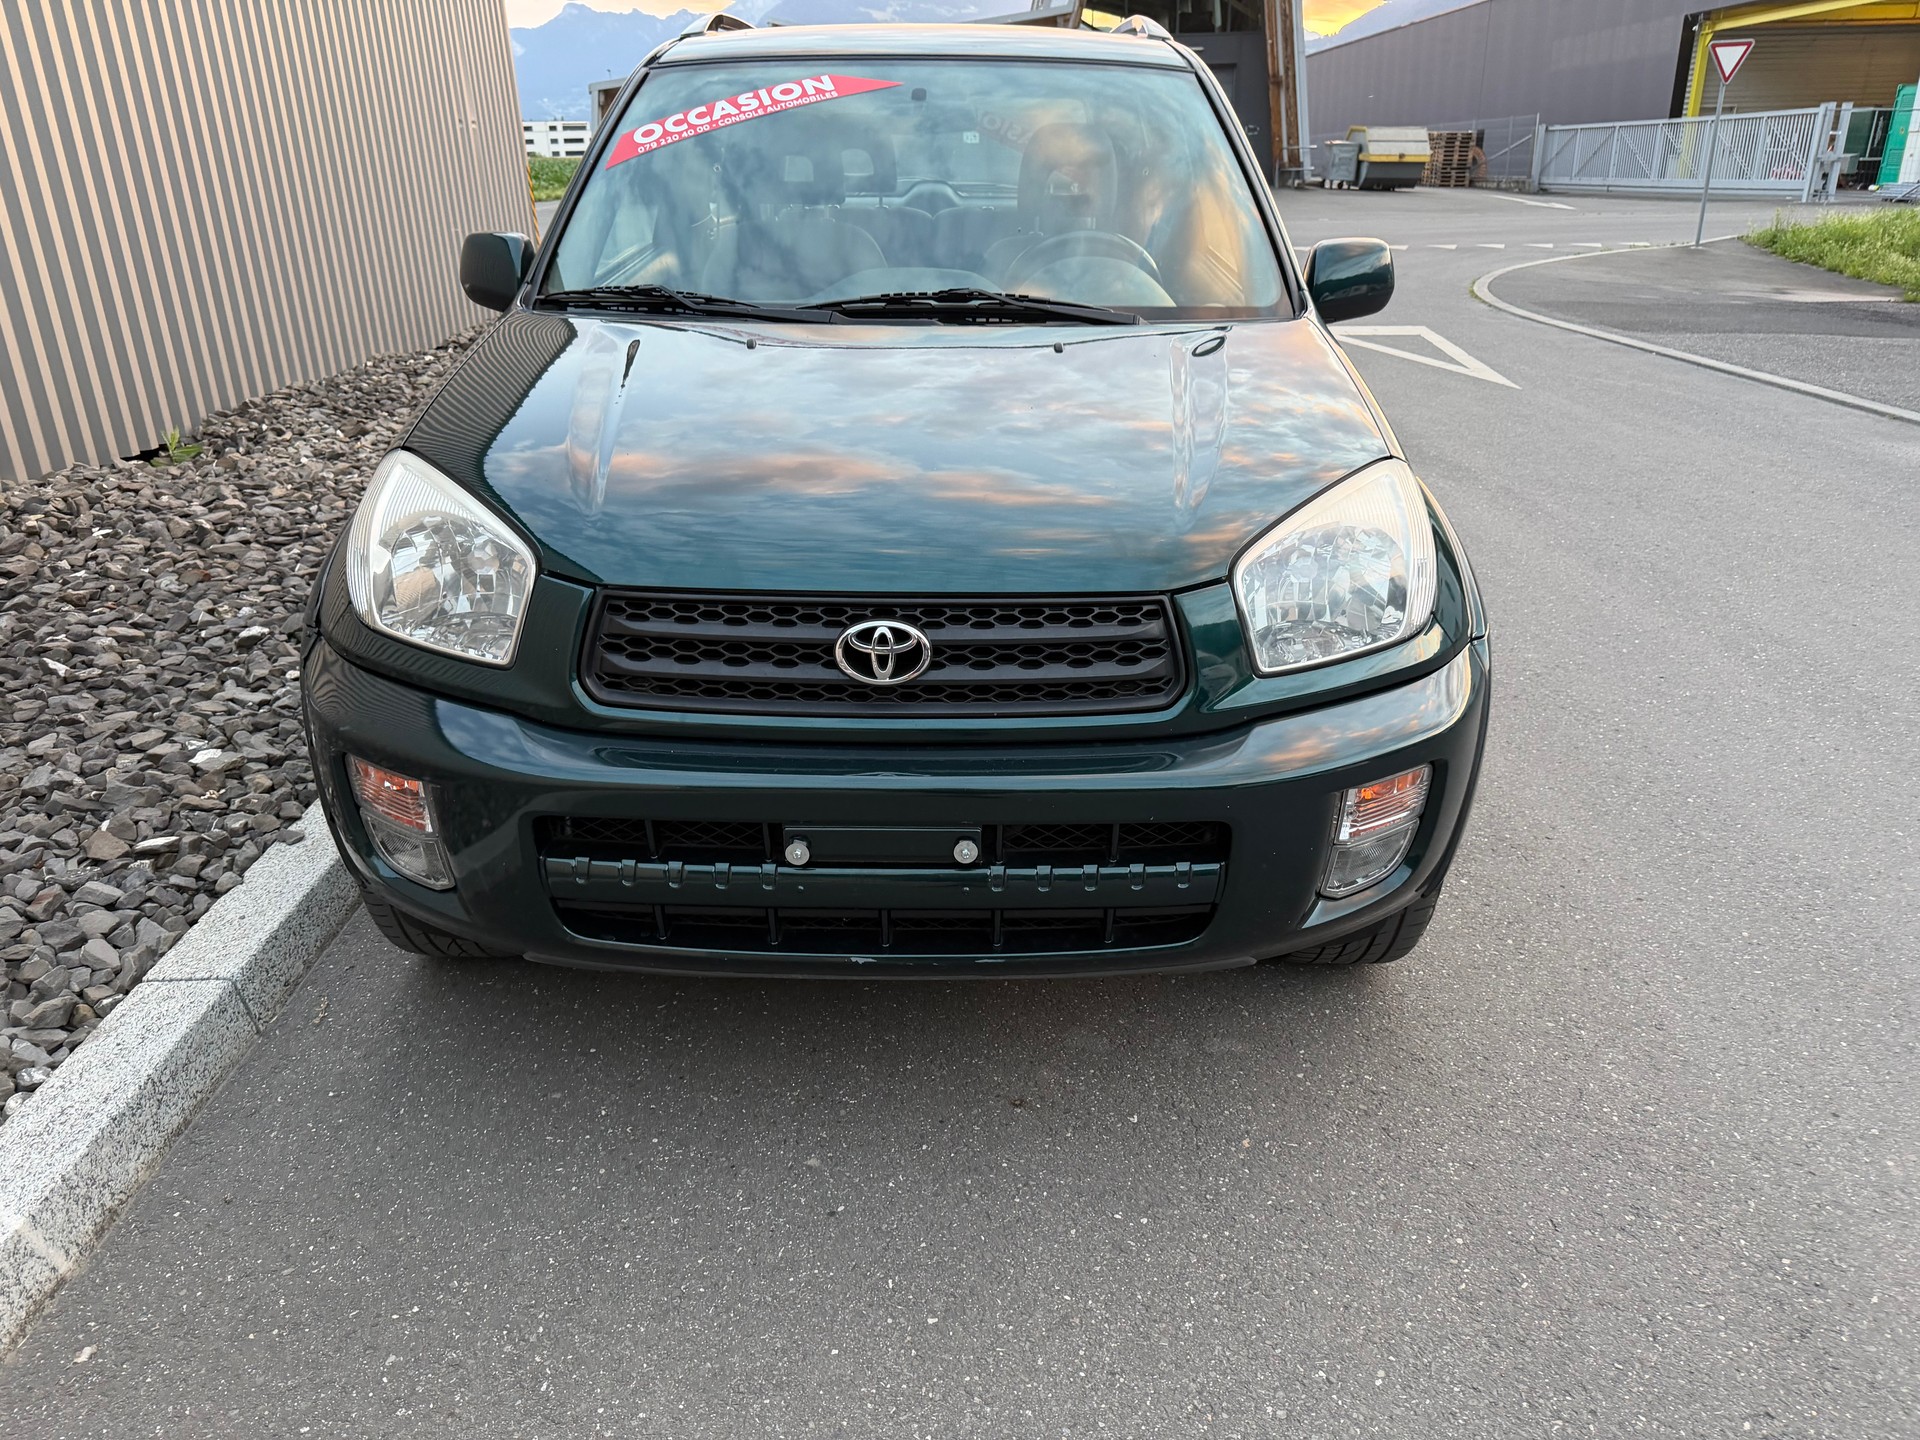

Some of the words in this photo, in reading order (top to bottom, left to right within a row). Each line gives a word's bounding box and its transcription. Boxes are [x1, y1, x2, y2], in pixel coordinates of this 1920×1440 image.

[633, 75, 836, 144] OCCASION
[637, 141, 658, 153] 079
[659, 134, 680, 145] 220
[681, 129, 695, 138] 40
[696, 124, 710, 133] 00
[718, 108, 765, 126] CONSOLE
[766, 91, 839, 113] AUTOMOBILES
